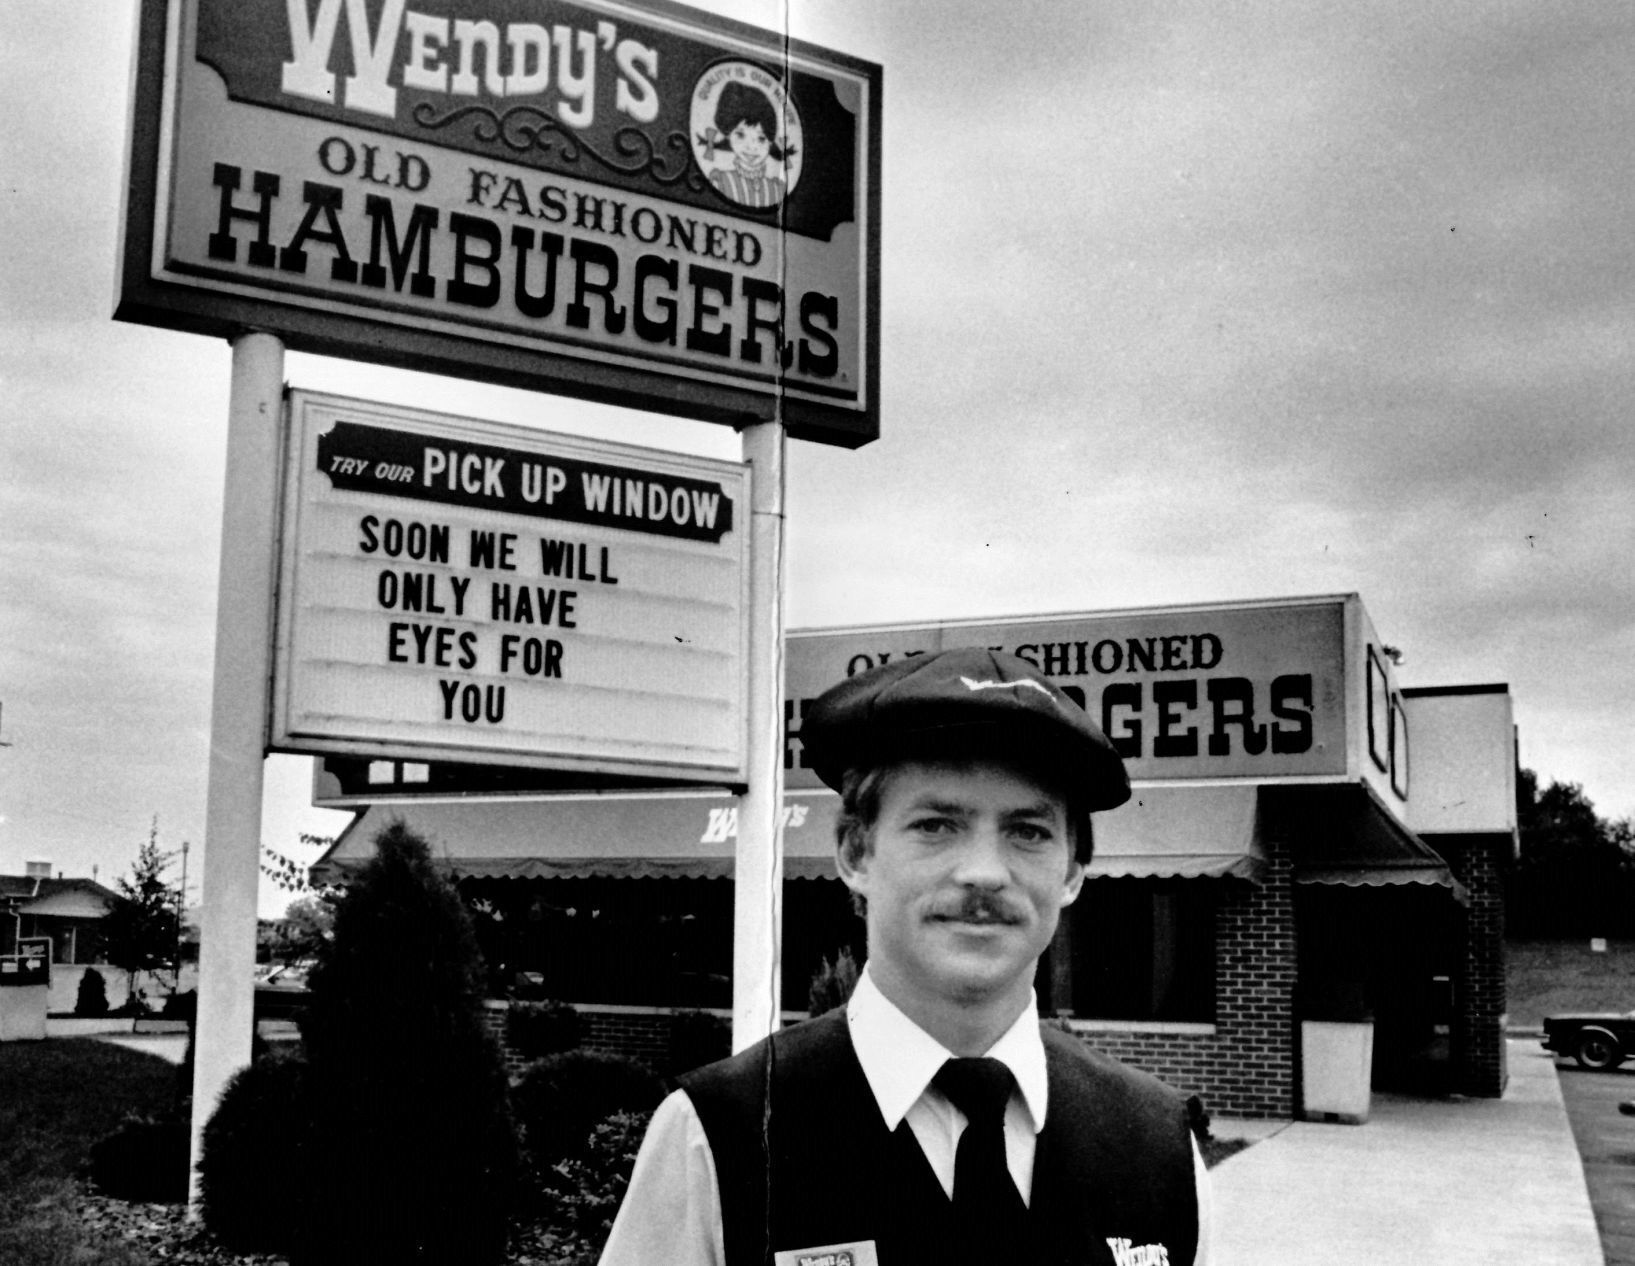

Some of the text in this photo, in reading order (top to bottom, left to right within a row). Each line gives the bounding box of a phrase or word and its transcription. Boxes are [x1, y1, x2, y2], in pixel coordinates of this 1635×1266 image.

[318, 136, 763, 267] OLD FASHIONED
[208, 162, 838, 378] HAMBURGERS
[330, 447, 720, 529] TRY OUR PICK UP WINDOW
[359, 514, 618, 585] SOON WE WILL
[378, 569, 577, 628] ONLY HAVE
[388, 622, 564, 679] EYES FOR
[439, 679, 506, 723] YOU
